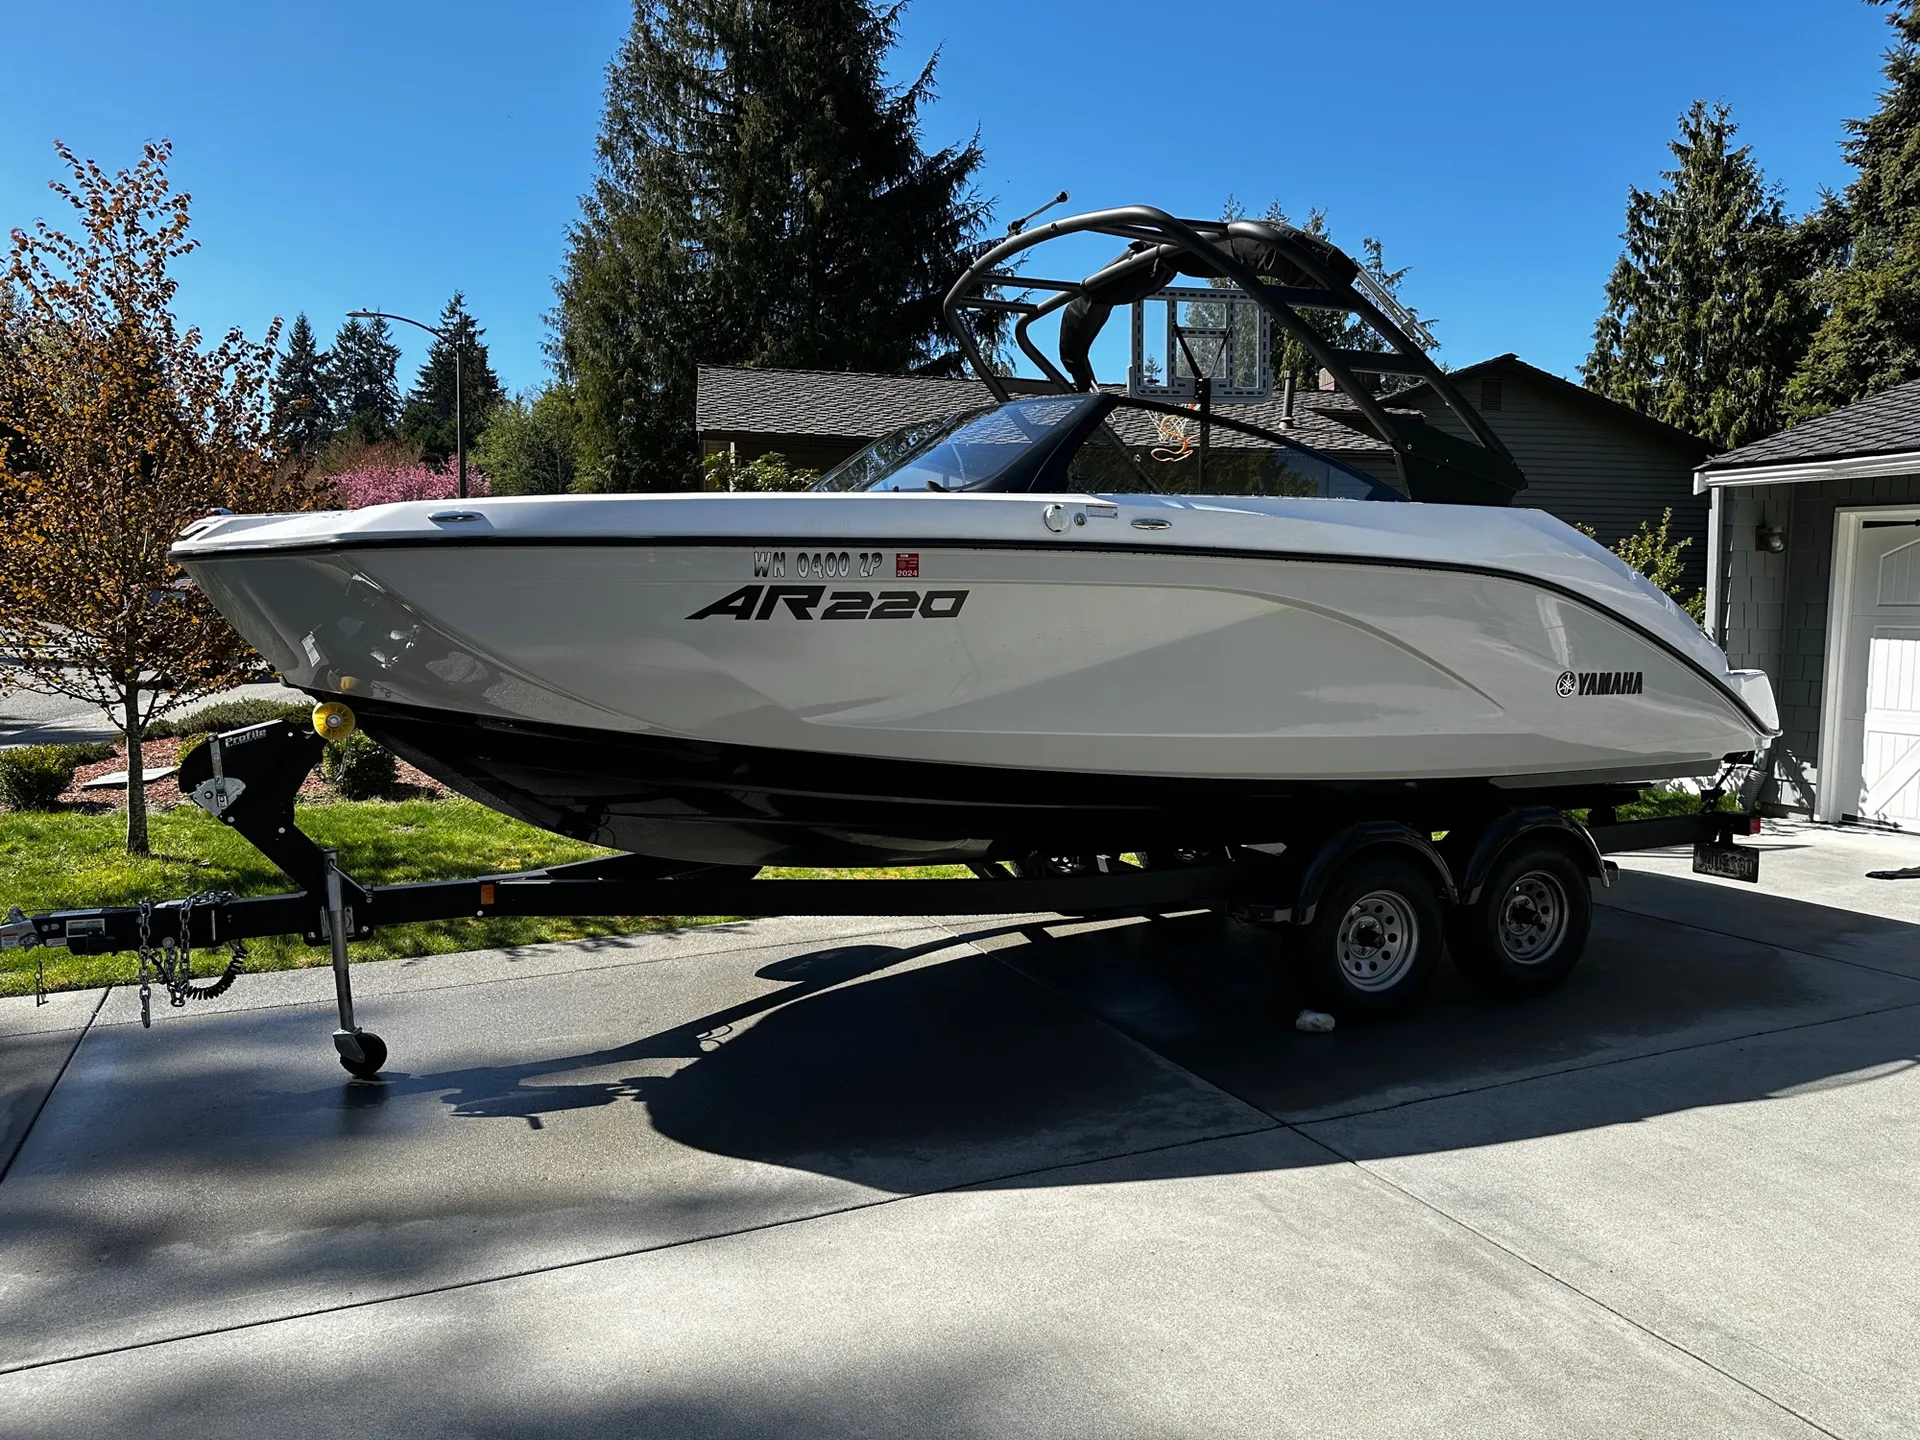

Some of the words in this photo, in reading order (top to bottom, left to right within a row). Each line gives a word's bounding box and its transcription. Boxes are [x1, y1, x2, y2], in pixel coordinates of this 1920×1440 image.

[754, 552, 785, 577] WN
[797, 552, 850, 578] 0400
[859, 553, 882, 577] ZP
[684, 585, 970, 620] AR220
[1578, 672, 1643, 695] YAMAHA
[225, 729, 266, 746] Profile
